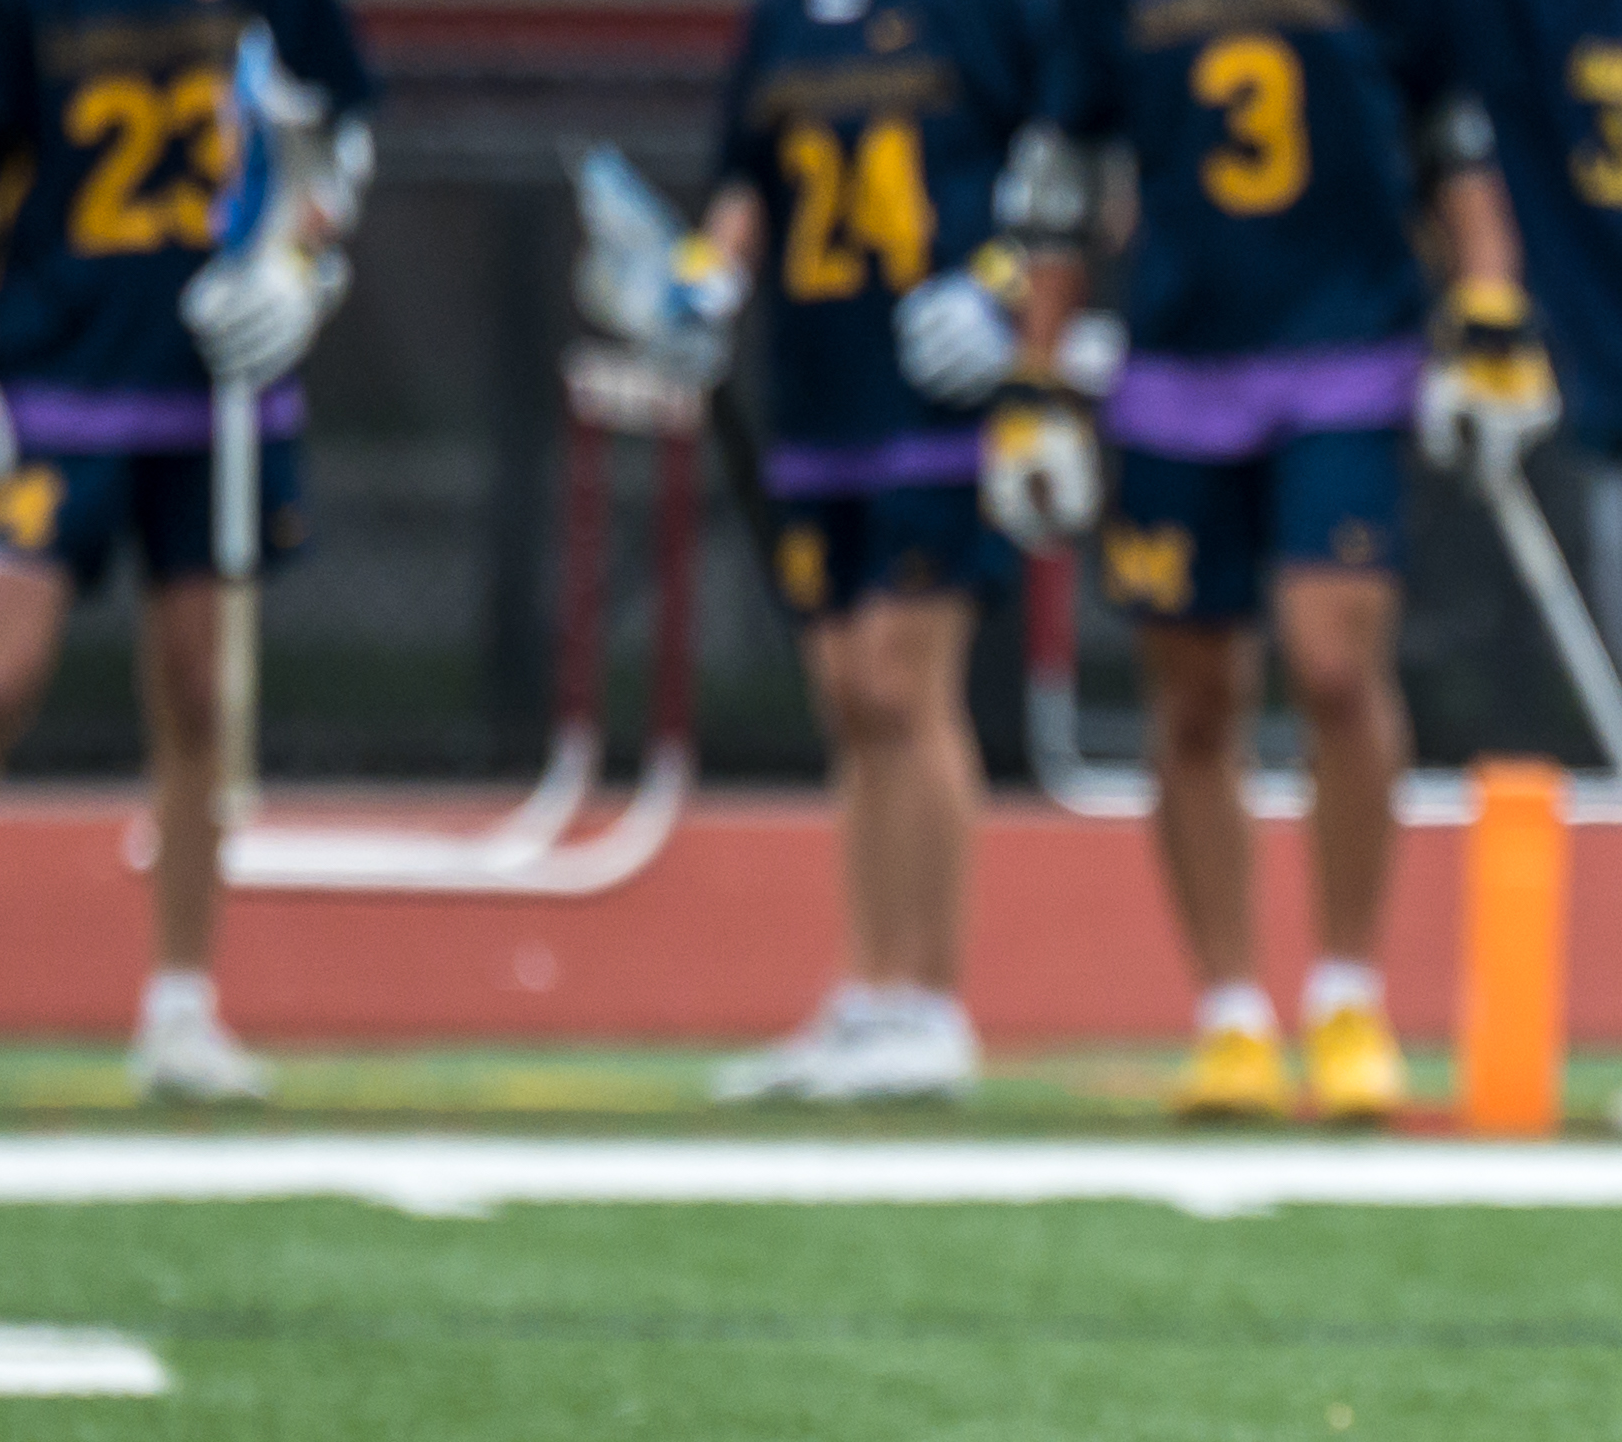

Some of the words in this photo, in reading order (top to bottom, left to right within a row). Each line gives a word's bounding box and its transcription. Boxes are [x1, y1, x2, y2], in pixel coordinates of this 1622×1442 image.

[64, 72, 238, 256] 23
[779, 118, 934, 301] 24
[1189, 38, 1311, 216] 3
